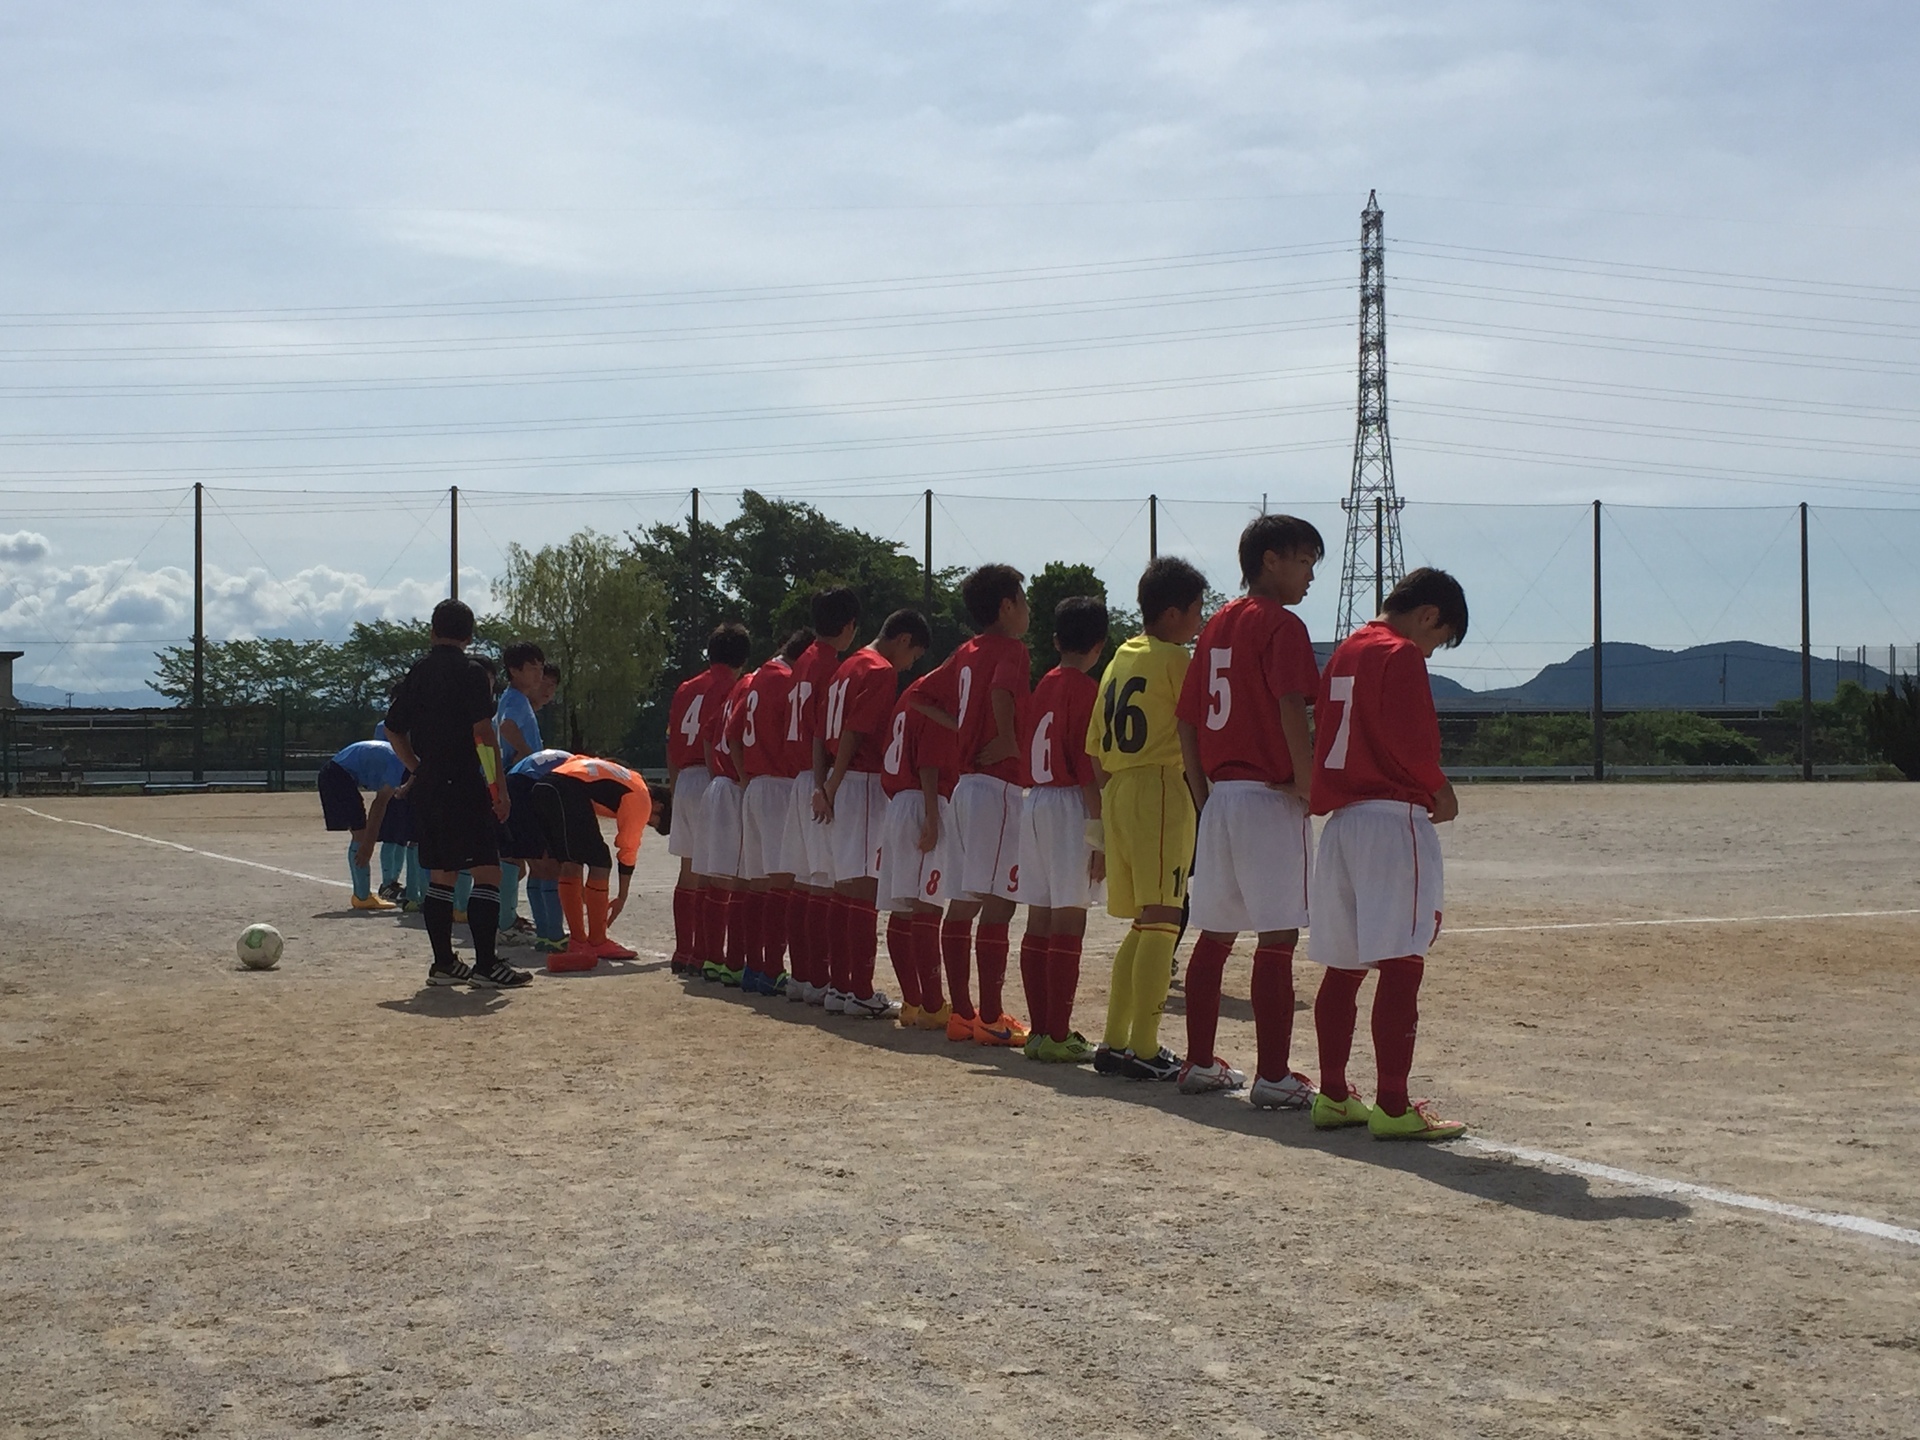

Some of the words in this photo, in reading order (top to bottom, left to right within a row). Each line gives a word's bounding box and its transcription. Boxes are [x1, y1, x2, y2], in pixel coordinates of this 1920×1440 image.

[681, 694, 704, 746] 4
[742, 690, 759, 747] 3
[826, 677, 850, 741] 11
[1102, 676, 1148, 754] 16
[1206, 646, 1233, 731] 5
[884, 711, 906, 775] 8
[1031, 711, 1054, 784] 6
[1324, 675, 1355, 770] 7
[926, 869, 941, 896] 8
